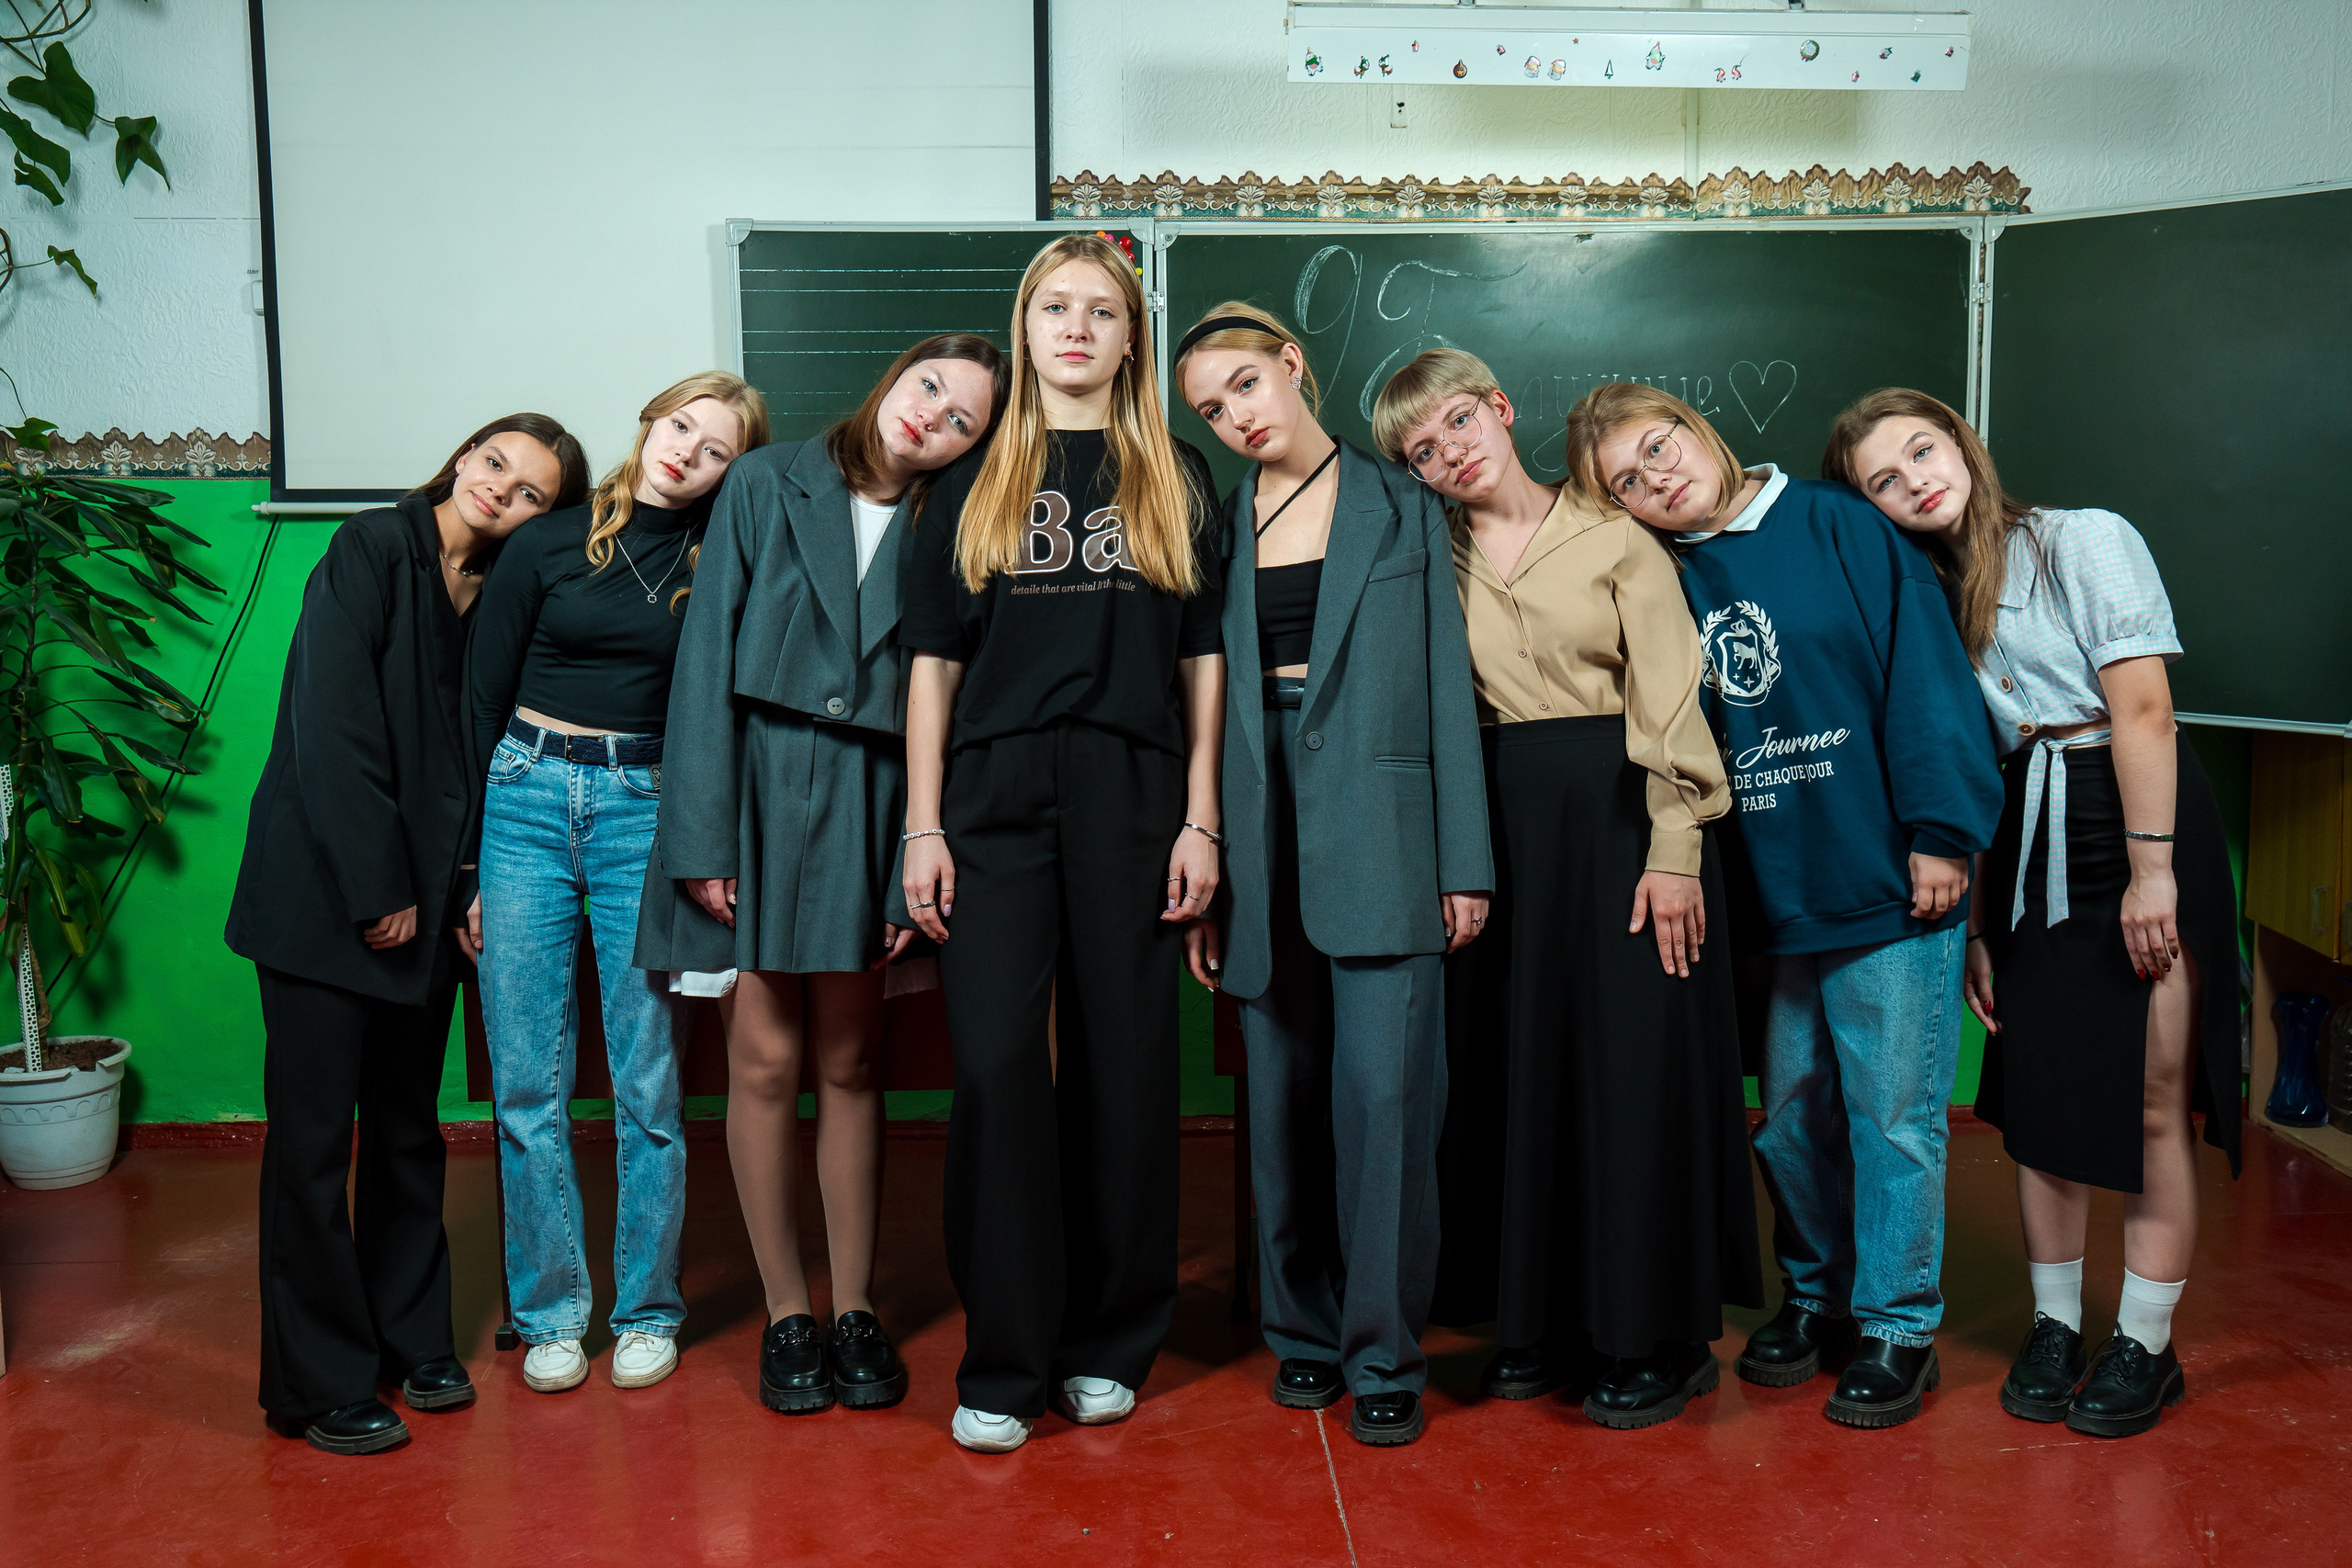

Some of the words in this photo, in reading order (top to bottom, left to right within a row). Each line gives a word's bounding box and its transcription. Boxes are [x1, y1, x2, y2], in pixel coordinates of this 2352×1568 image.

[1041, 583, 1060, 594] that
[1061, 584, 1076, 593] are
[1077, 581, 1097, 592] vital
[1115, 578, 1136, 592] little
[1736, 726, 1851, 770] Journee
[1734, 773, 1753, 790] DE
[1755, 765, 1807, 787] CHAQUE
[1741, 793, 1778, 813] PARIS
